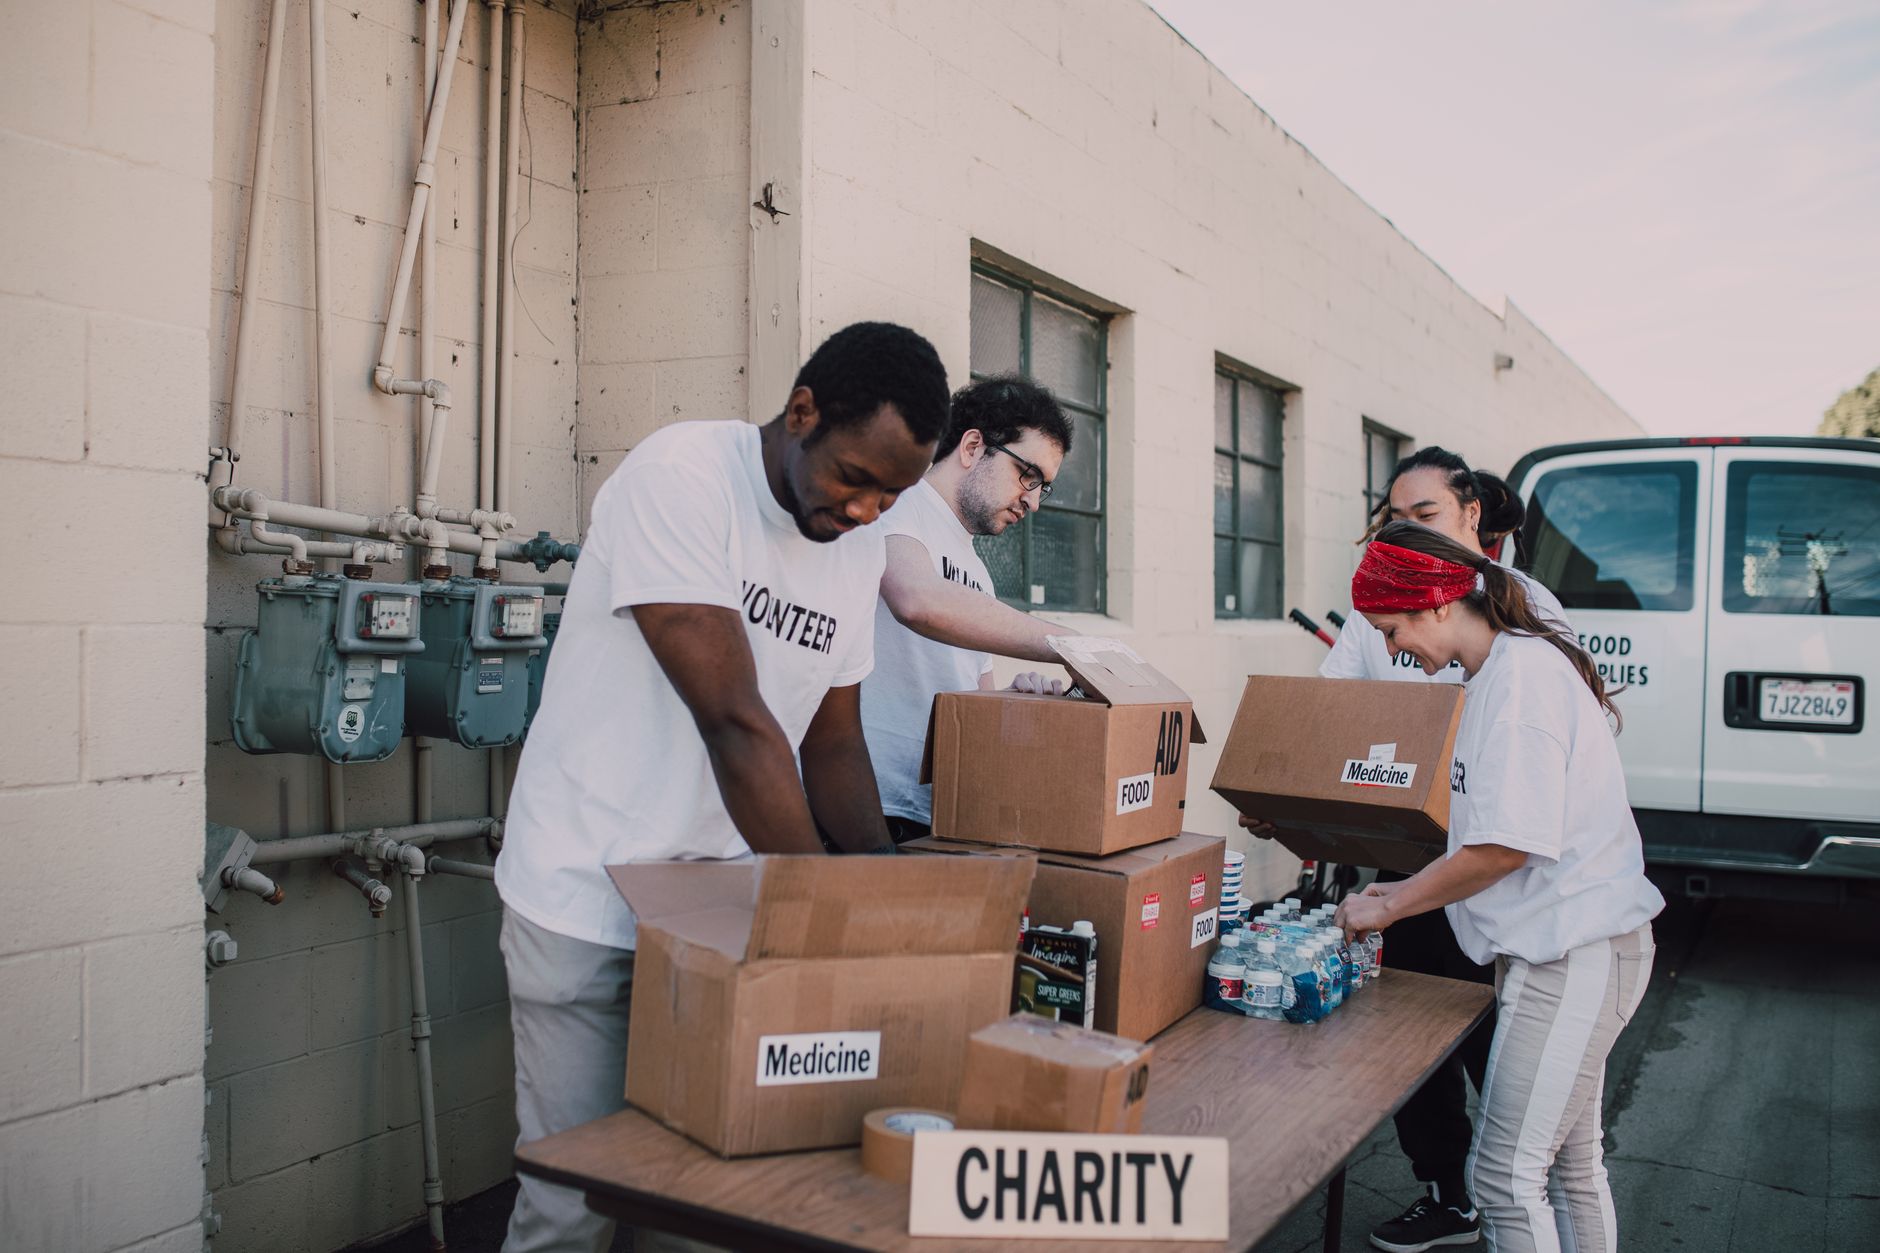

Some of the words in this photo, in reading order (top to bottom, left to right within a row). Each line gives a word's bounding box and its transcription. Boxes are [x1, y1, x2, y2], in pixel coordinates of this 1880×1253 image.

[743, 580, 837, 655] VOLNTEER
[1578, 634, 1631, 656] FOOD
[1598, 664, 1648, 686] PLIES
[1768, 694, 1847, 717] 7J22849
[1154, 711, 1183, 776] AID
[1347, 762, 1409, 785] Medicine
[1121, 780, 1150, 807] FOOD
[1195, 917, 1214, 939] FOOD
[1037, 984, 1058, 998] SUPER
[1058, 987, 1081, 1003] GREENS
[765, 1040, 871, 1077] Medicine
[955, 1146, 1195, 1225] CHARITY
